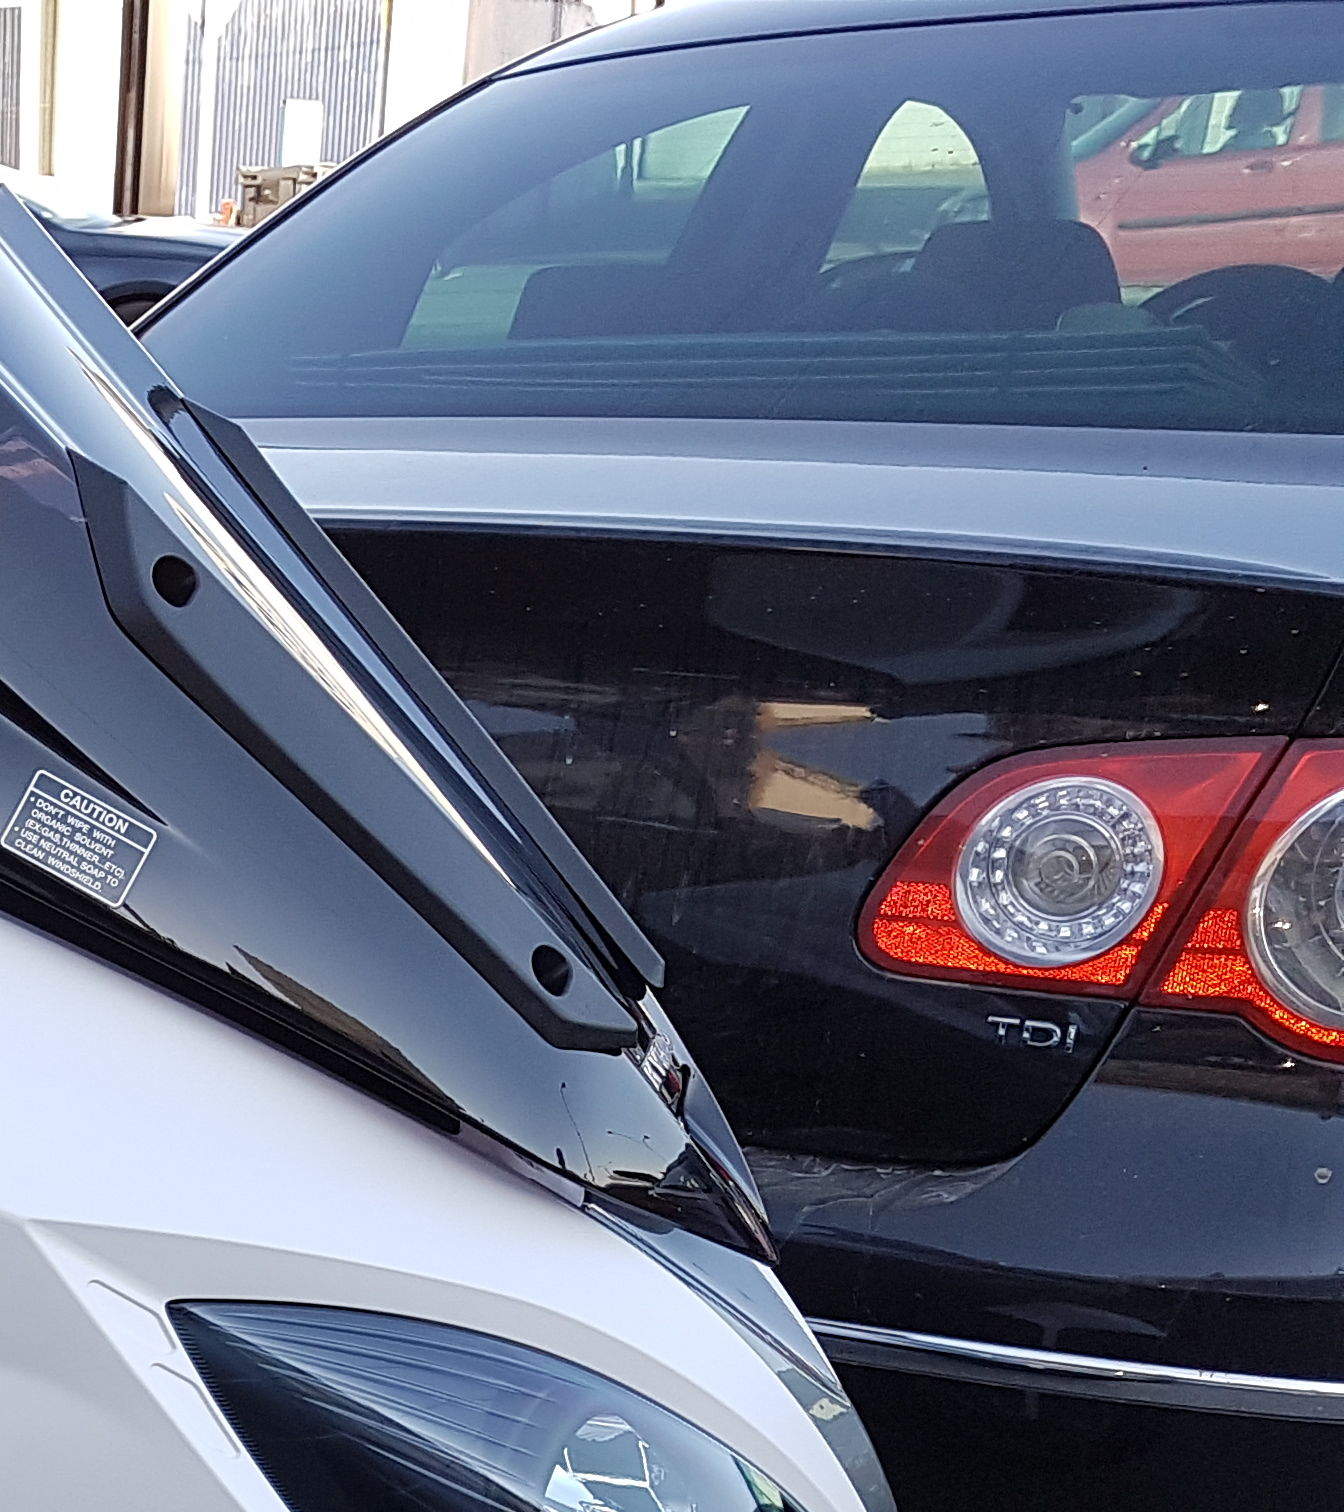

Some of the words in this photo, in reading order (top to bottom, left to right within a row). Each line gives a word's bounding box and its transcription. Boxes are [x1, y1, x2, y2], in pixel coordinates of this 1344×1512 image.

[31, 808, 72, 836] ORGANIC
[74, 833, 114, 859] SOLVENT
[36, 798, 65, 819] DON'T
[67, 815, 90, 834] WIPE
[93, 828, 116, 848] WITH
[60, 789, 129, 834] CAUTION
[15, 838, 45, 860] CLEAN
[20, 829, 39, 843] USE
[39, 839, 78, 867] NEUTRAL
[81, 861, 105, 879] SOAP
[106, 875, 119, 887] TO
[986, 1014, 1078, 1054] TDI
